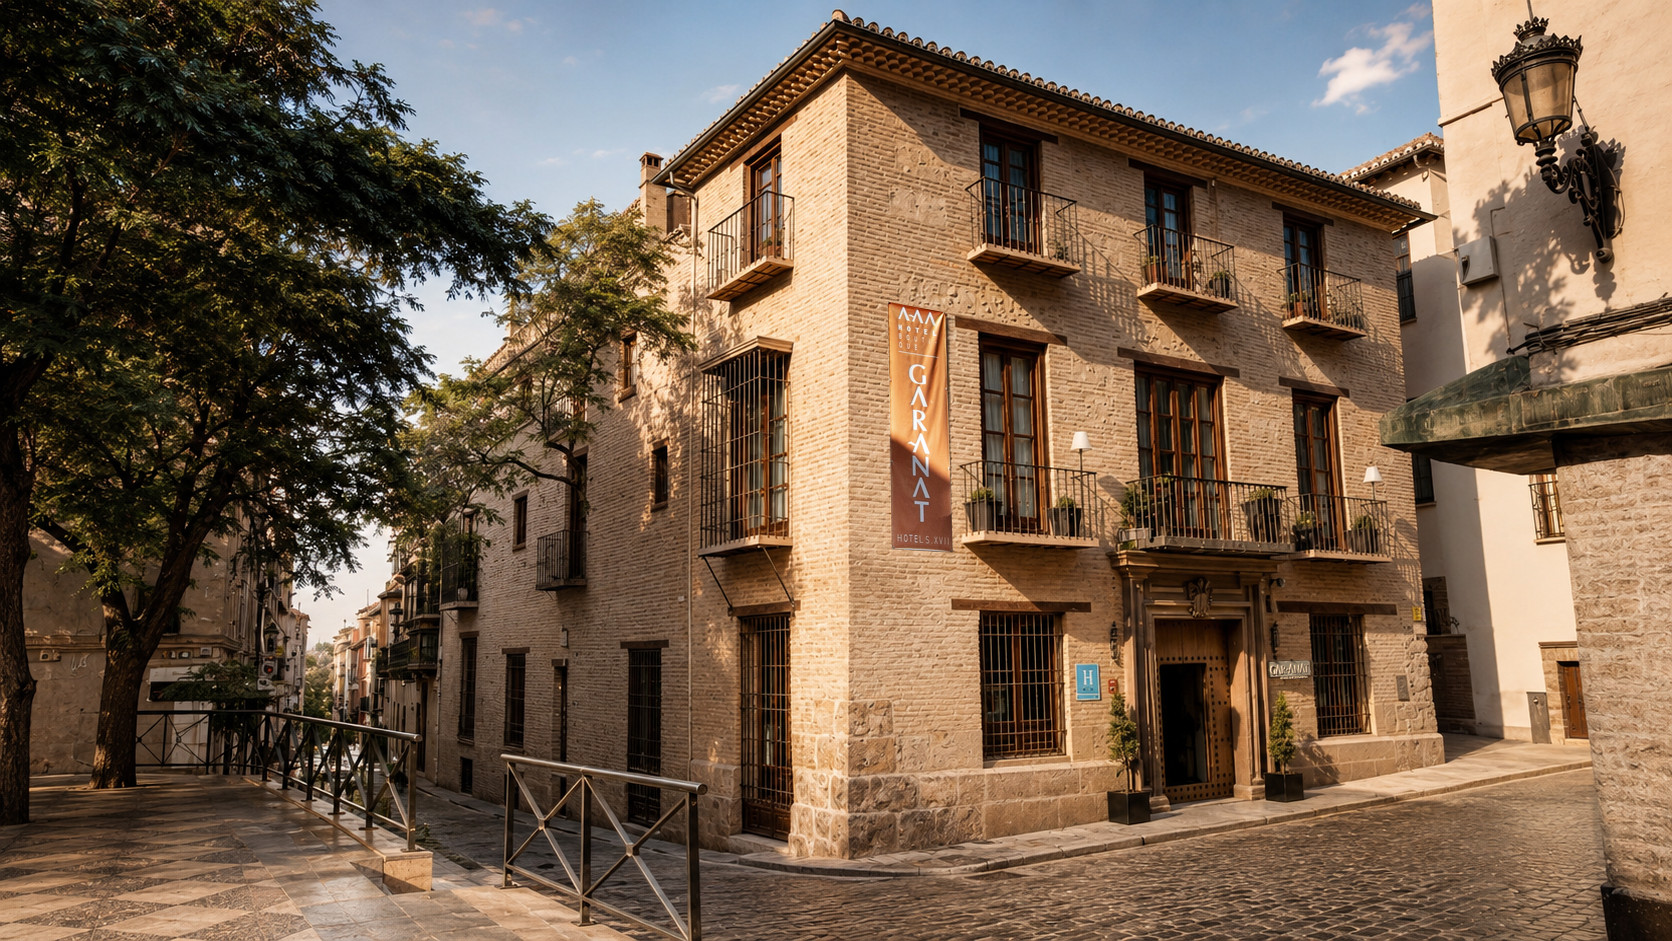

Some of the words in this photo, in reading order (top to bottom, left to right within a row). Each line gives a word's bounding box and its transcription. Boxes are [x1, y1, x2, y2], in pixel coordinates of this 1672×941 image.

[898, 324, 937, 336] HOTEL
[908, 364, 930, 522] GARANAT
[1082, 670, 1093, 685] H
